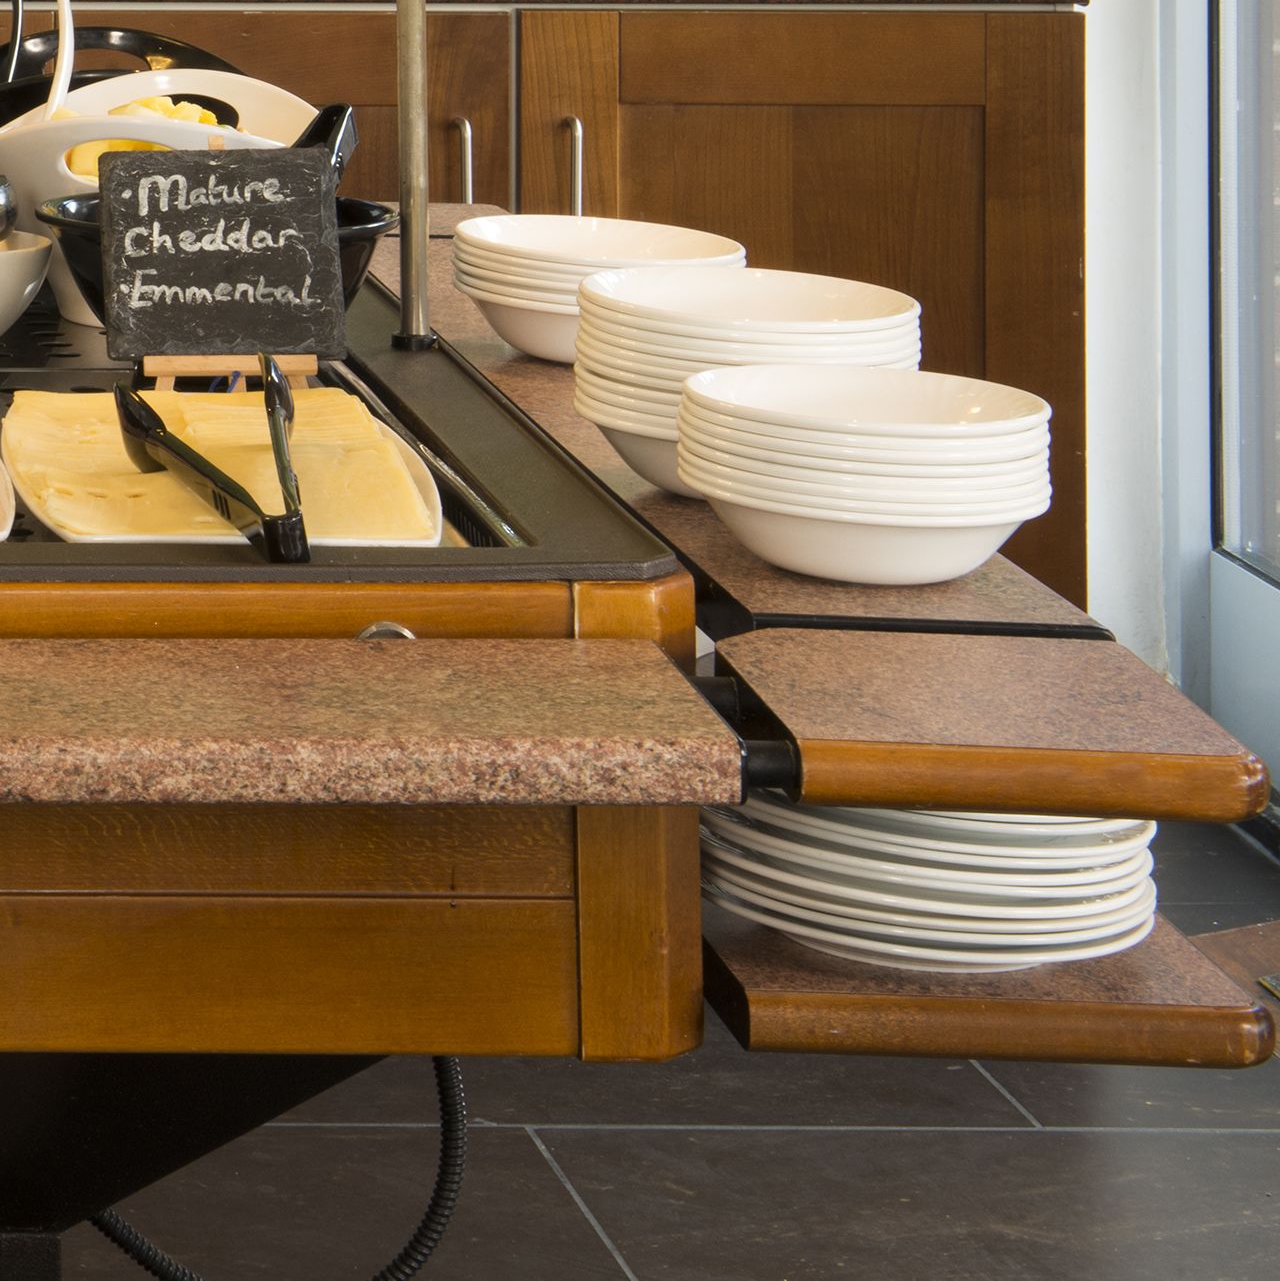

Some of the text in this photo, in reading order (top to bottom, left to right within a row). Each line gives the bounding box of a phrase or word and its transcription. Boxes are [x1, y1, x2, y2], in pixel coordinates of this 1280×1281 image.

[138, 173, 288, 217] Mature
[124, 217, 304, 258] Cheddar
[128, 268, 322, 310] Emmental
